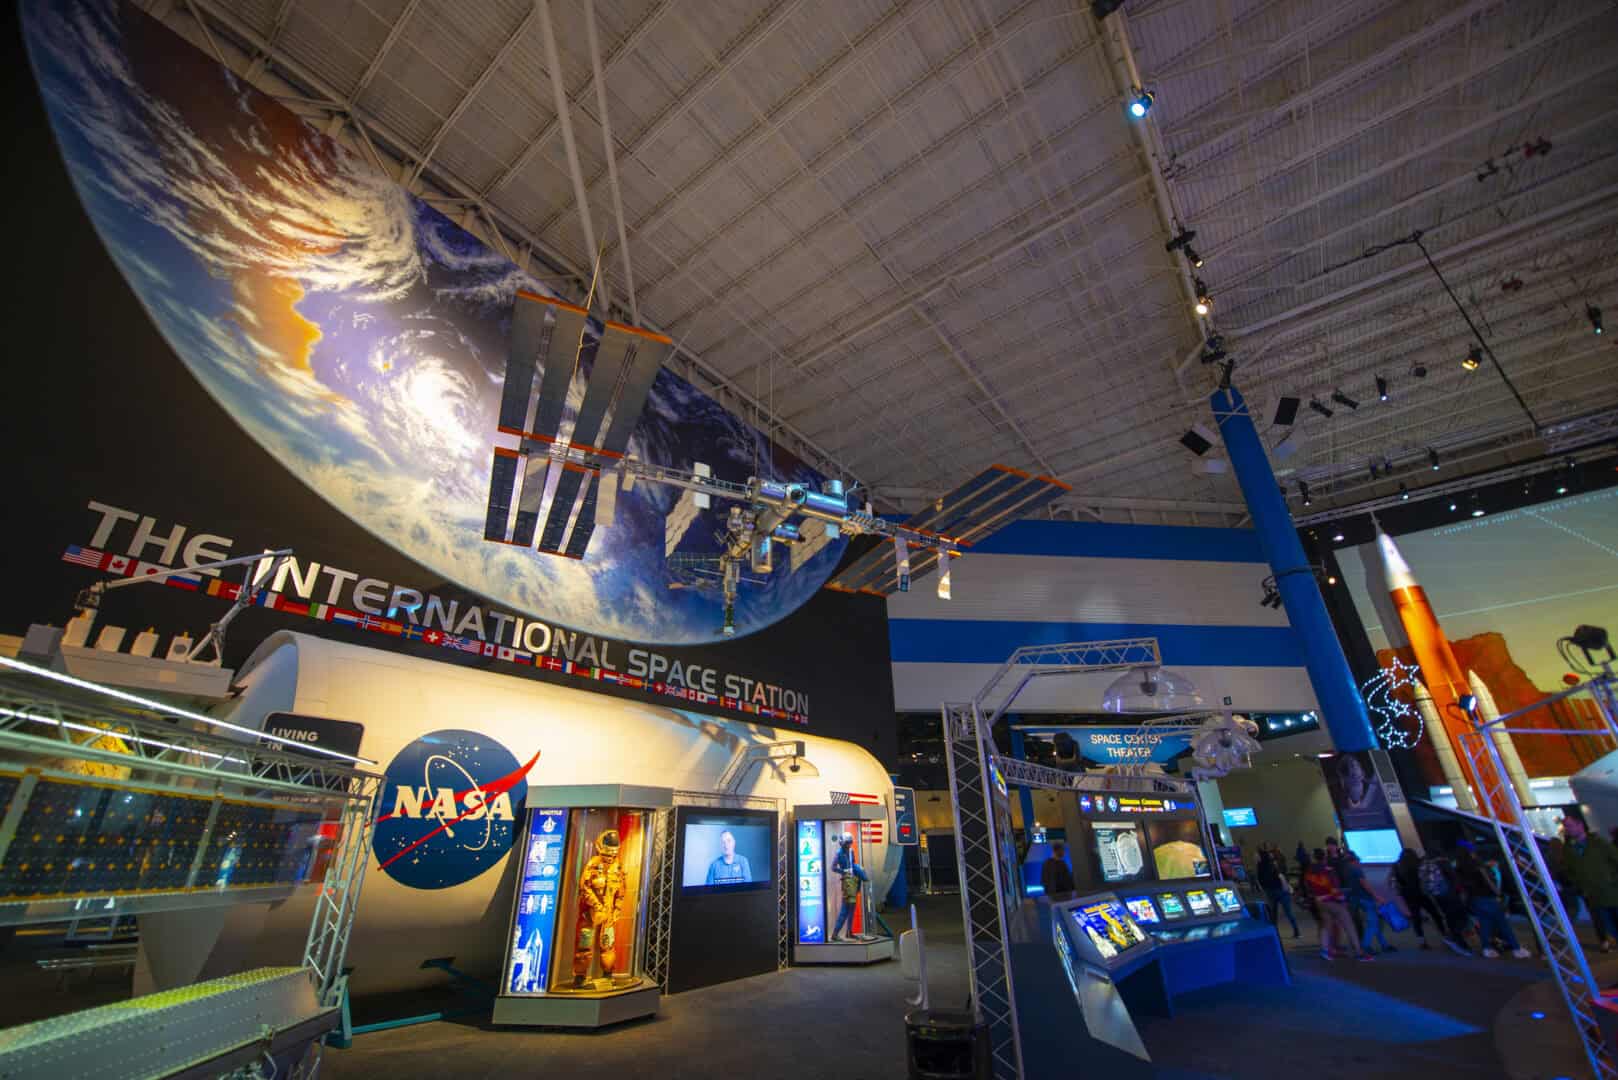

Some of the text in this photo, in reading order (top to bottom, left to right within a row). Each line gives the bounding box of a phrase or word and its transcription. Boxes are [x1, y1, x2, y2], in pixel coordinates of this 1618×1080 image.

[87, 500, 809, 715] THE INTERNATIONAL SPACE STATION
[271, 727, 319, 741] LIVING
[1090, 734, 1122, 745] SPACE
[1106, 747, 1151, 758] THEATER
[391, 785, 514, 821] NASA
